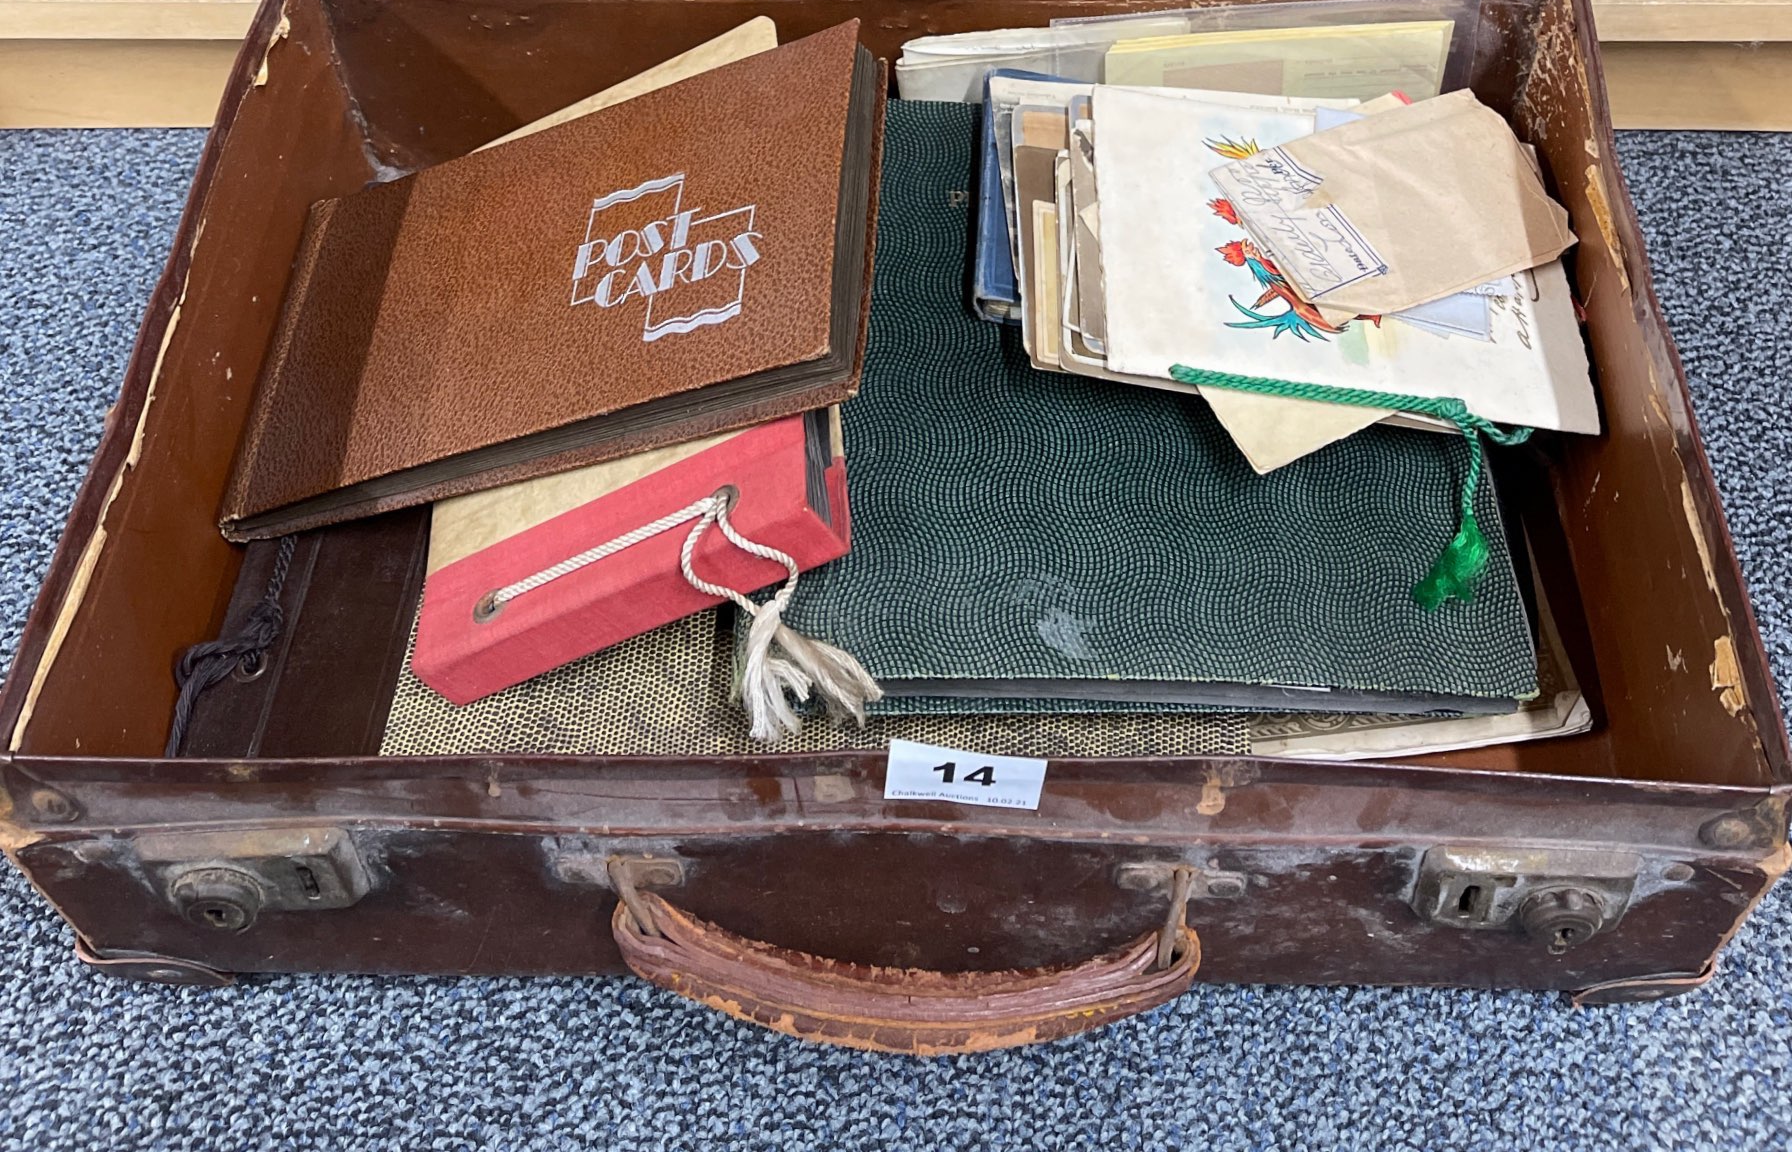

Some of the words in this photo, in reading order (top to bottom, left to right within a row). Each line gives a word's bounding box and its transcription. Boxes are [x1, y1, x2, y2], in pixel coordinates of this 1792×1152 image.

[572, 207, 701, 281] POST
[595, 231, 763, 308] CARDS
[891, 789, 937, 798] Chalkwell
[938, 791, 979, 803] Auctions
[932, 761, 997, 787] 14
